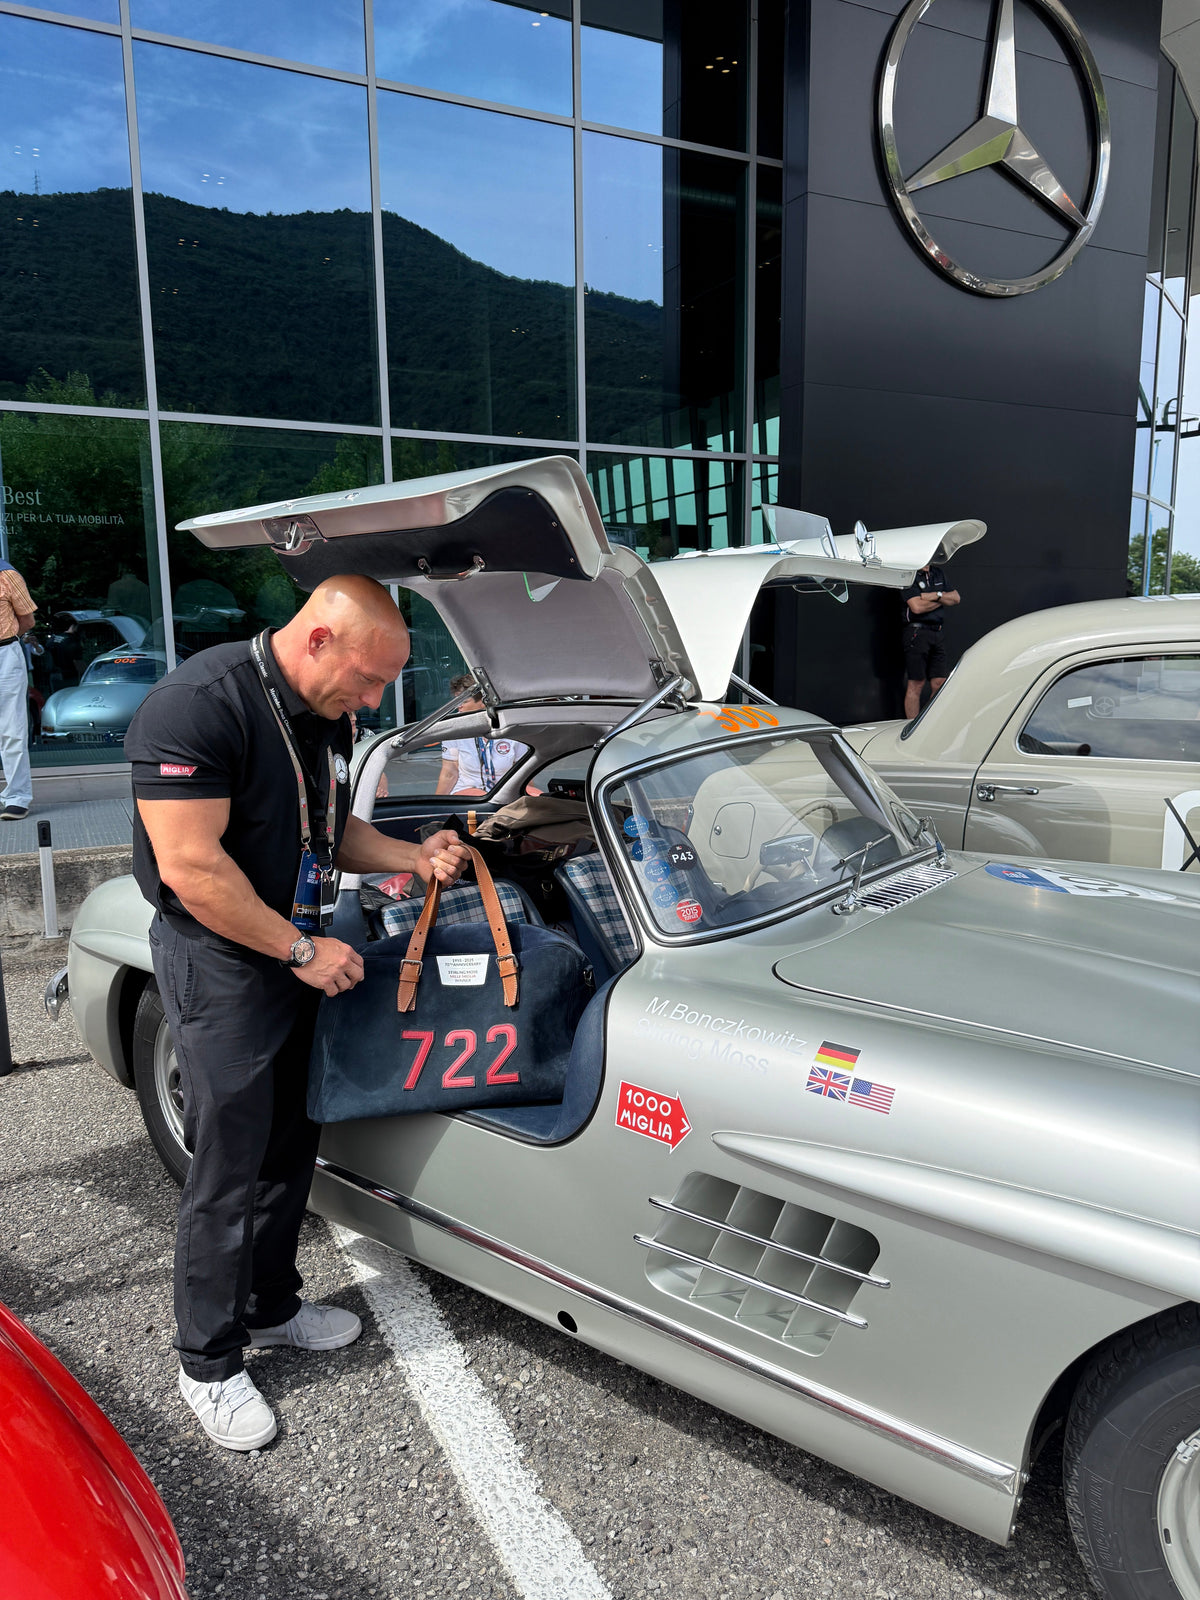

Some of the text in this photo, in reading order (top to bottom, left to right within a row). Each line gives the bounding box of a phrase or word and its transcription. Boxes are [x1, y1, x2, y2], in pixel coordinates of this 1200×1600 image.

[1, 485, 42, 506] Best
[17, 512, 36, 522] PER
[40, 513, 53, 523] LA
[55, 513, 76, 524] TUA
[79, 513, 125, 525] MOBILITÀ
[671, 851, 694, 863] P43
[681, 907, 698, 917] 2015
[401, 1023, 519, 1090] 722
[710, 1038, 769, 1074] Moss
[626, 1088, 672, 1117] 1000
[620, 1108, 673, 1140] MIGLIA
